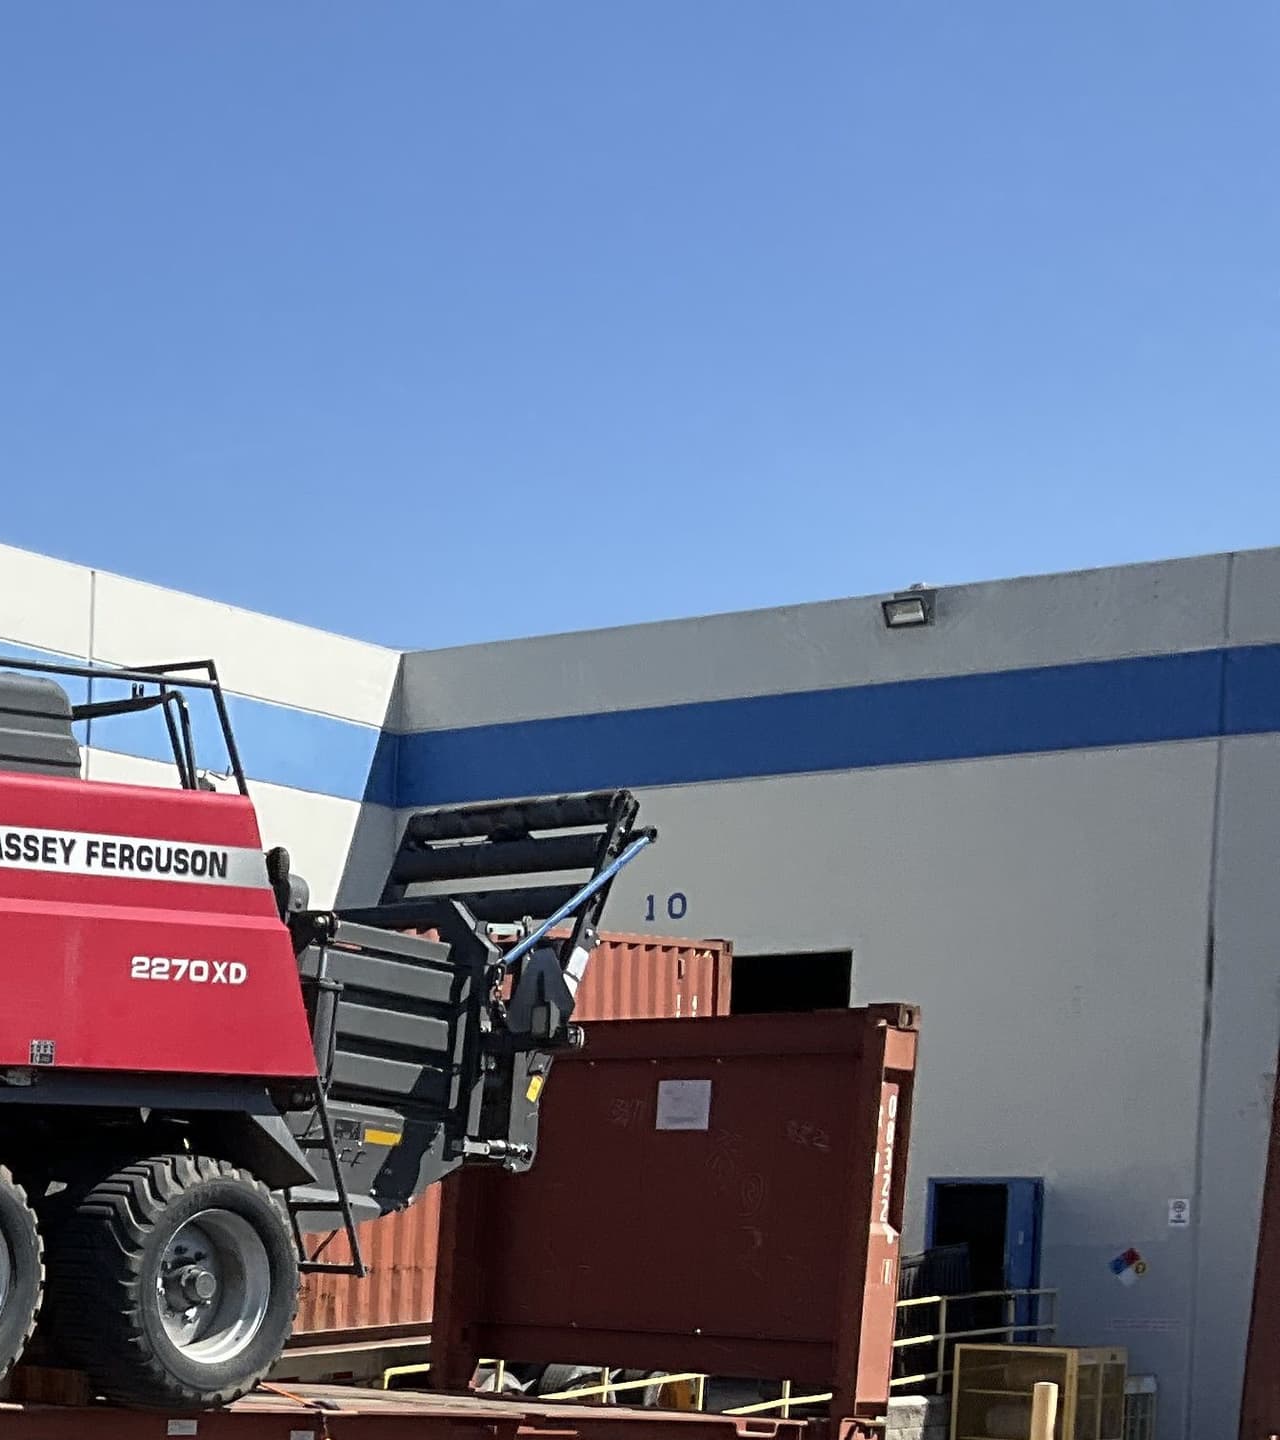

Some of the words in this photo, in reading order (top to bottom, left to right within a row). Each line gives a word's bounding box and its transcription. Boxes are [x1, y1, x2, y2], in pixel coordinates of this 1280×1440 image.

[86, 840, 228, 878] FERGUSON
[645, 892, 687, 921] 10
[130, 956, 248, 985] 2270XD
